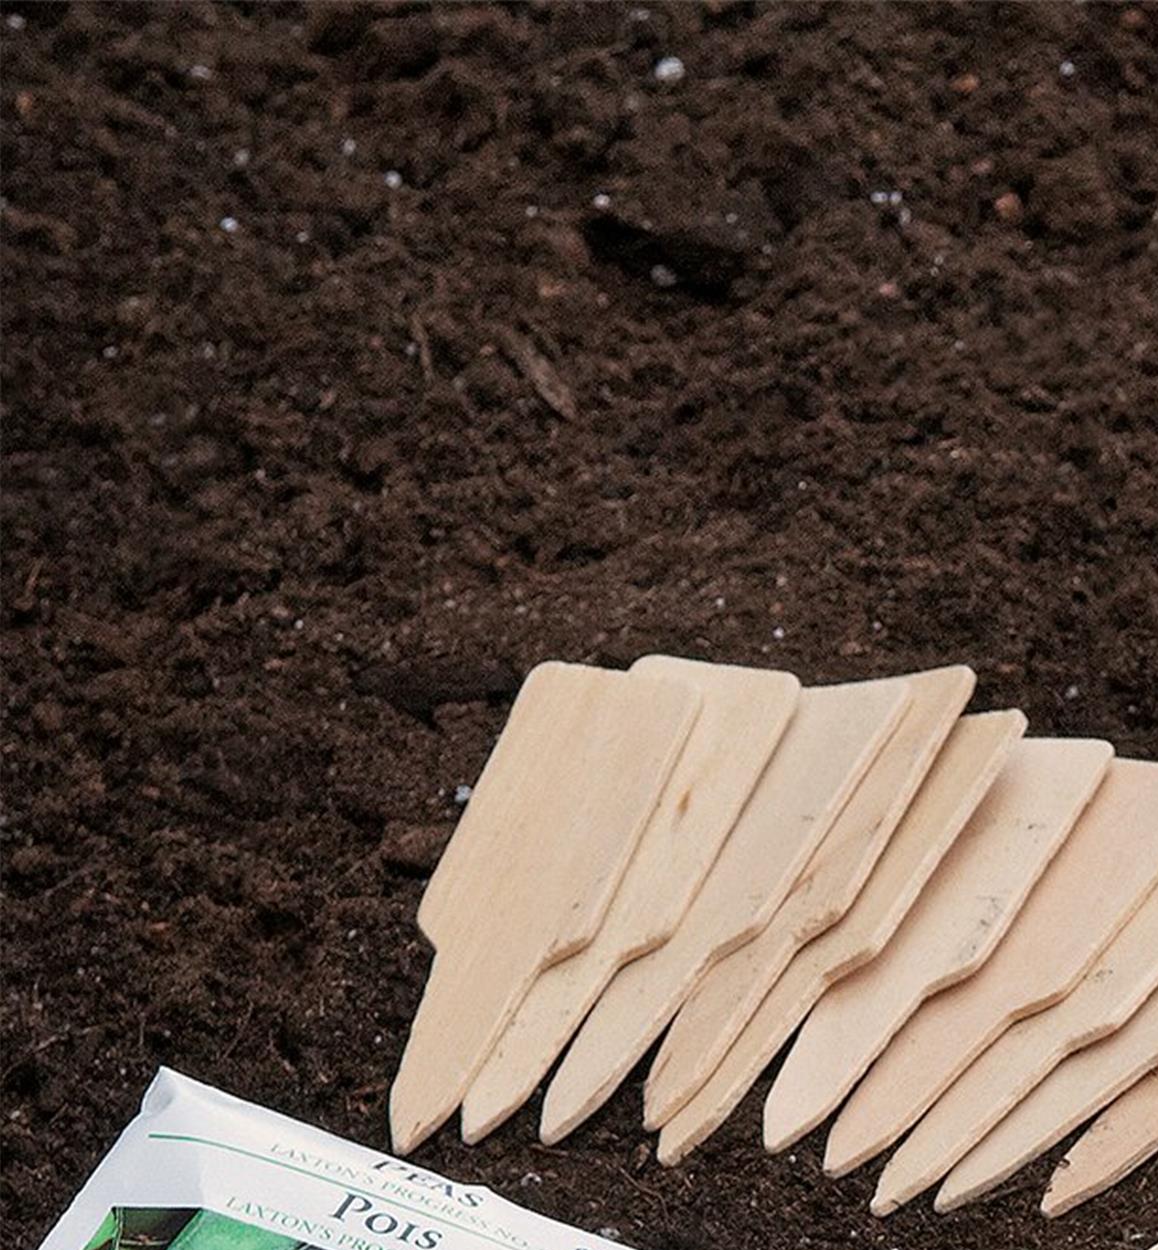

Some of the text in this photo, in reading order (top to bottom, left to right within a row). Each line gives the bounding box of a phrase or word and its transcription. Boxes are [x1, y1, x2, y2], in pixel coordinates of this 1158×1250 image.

[270, 1143, 376, 1186] LAXTON'S
[381, 1180, 489, 1229] PROGRESS
[371, 1159, 484, 1208] PEAS
[226, 1196, 333, 1241] LAXTON'S
[329, 1191, 444, 1250] POIS
